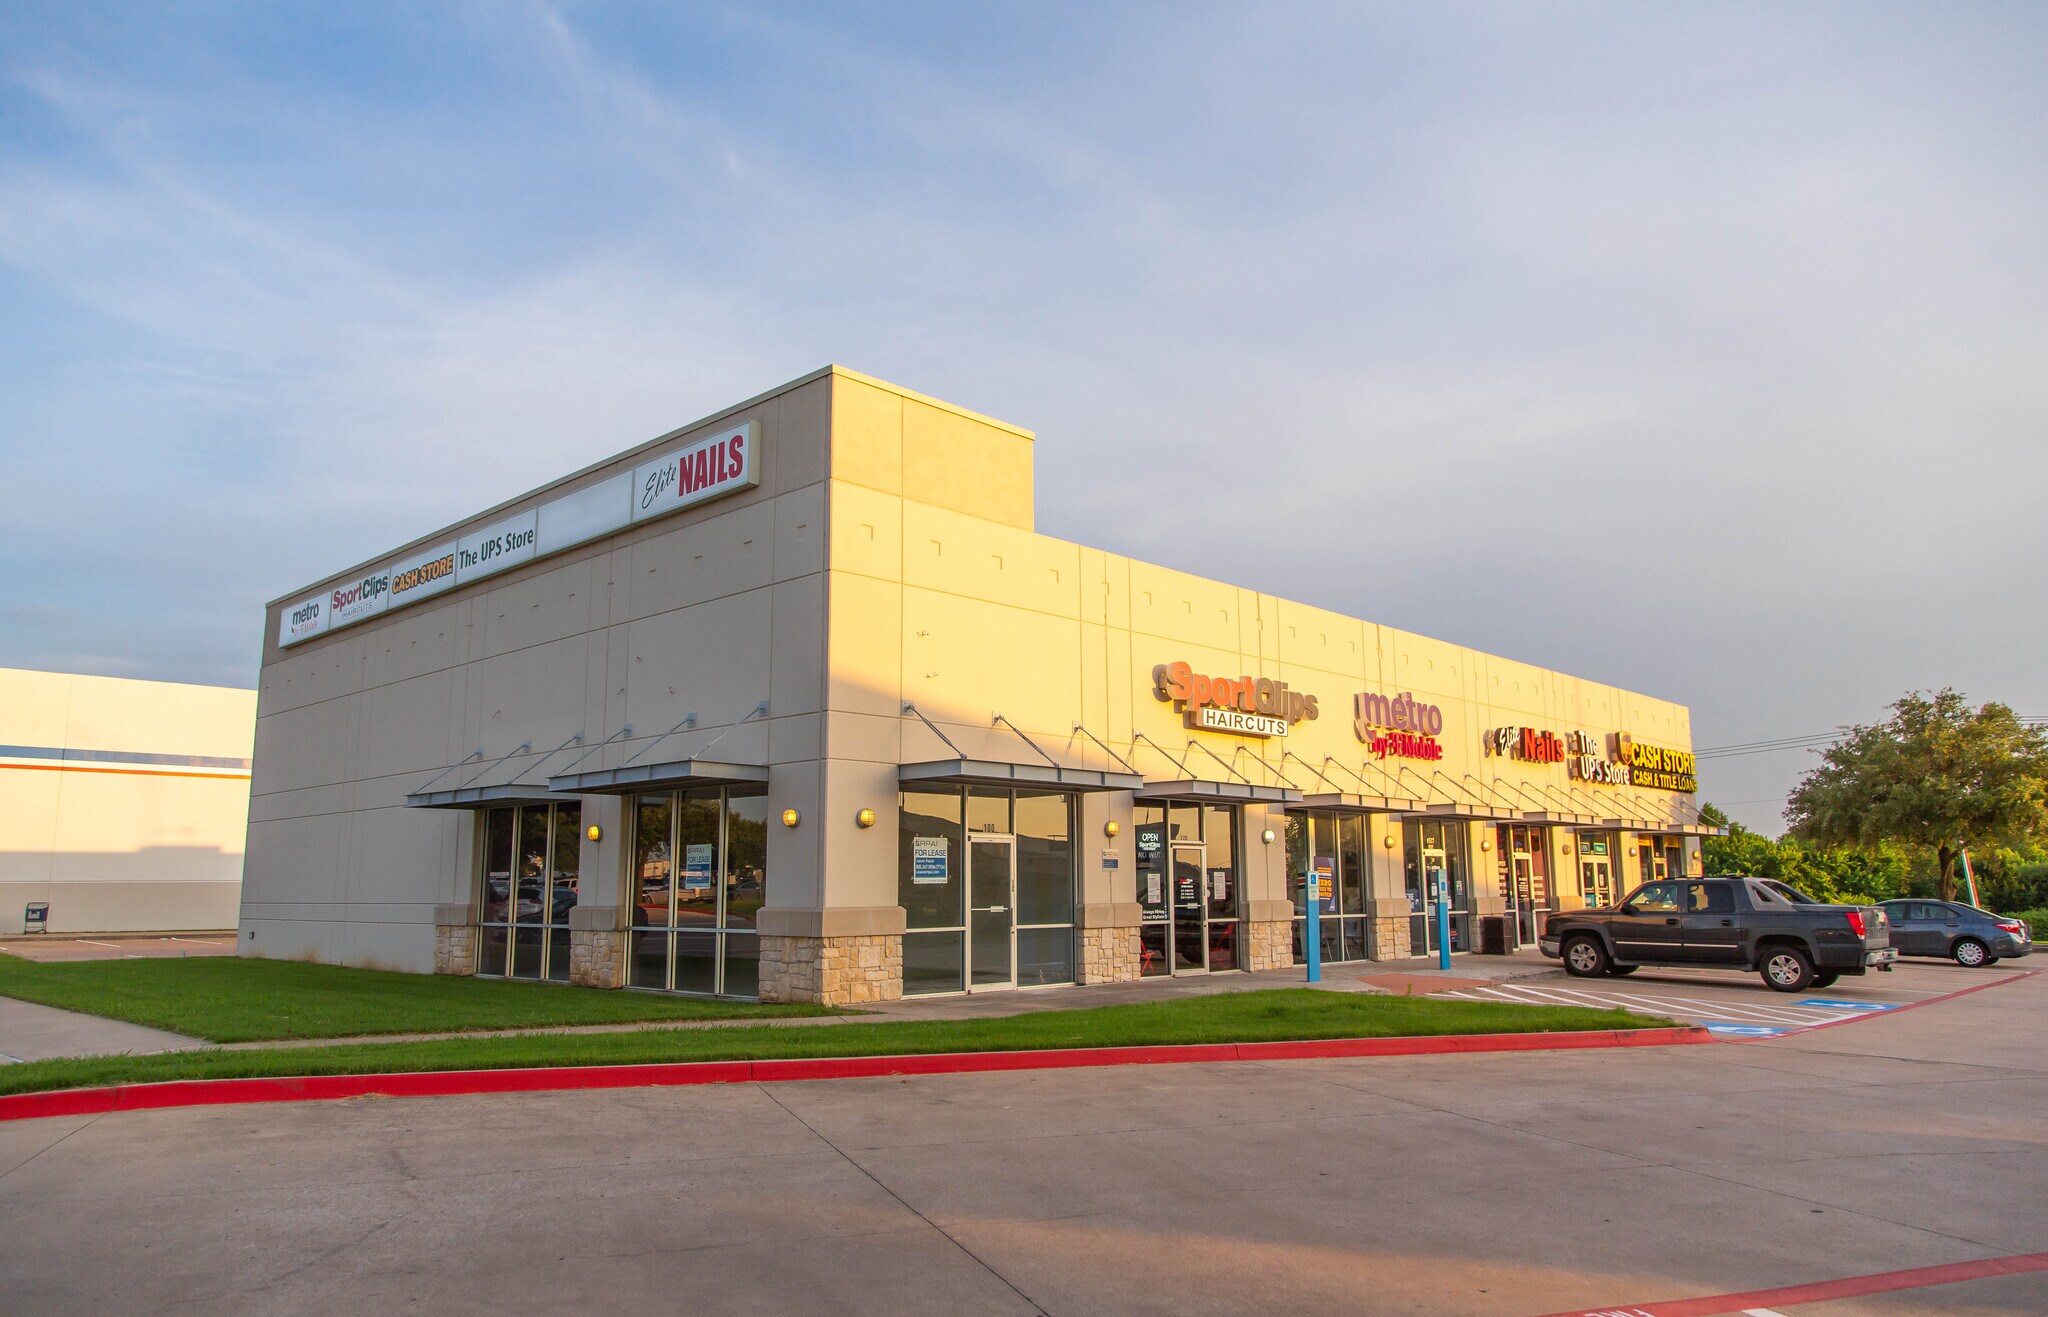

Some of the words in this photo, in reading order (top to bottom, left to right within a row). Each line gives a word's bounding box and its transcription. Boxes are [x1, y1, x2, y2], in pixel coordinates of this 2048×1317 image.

[642, 462, 677, 510] Elite
[678, 434, 744, 497] NAILS
[459, 549, 477, 569] The
[481, 537, 502, 561] UPS
[505, 529, 533, 553] Store
[392, 567, 419, 594] CASH
[420, 554, 454, 585] STORE
[333, 576, 388, 612] SportClips
[292, 603, 320, 626] metro
[342, 601, 373, 618] HAIRCUTS
[1167, 661, 1319, 726] SportClips
[1205, 710, 1286, 735] HAIRCUTS
[1363, 692, 1442, 736] metro
[1499, 726, 1521, 757] Elite
[1524, 727, 1564, 763] Nails
[1578, 730, 1600, 755] The
[1580, 757, 1603, 780] UPS
[1604, 761, 1630, 785] Store
[1631, 743, 1662, 770] CASH
[1663, 750, 1698, 775] STORE
[1633, 770, 1654, 786] CASH
[1659, 775, 1678, 789] TITLE
[1142, 833, 1159, 841] OPEN
[688, 856, 697, 864] FOR
[697, 855, 710, 863] LEASE
[915, 849, 927, 857] FOR
[928, 849, 946, 857] LEASE
